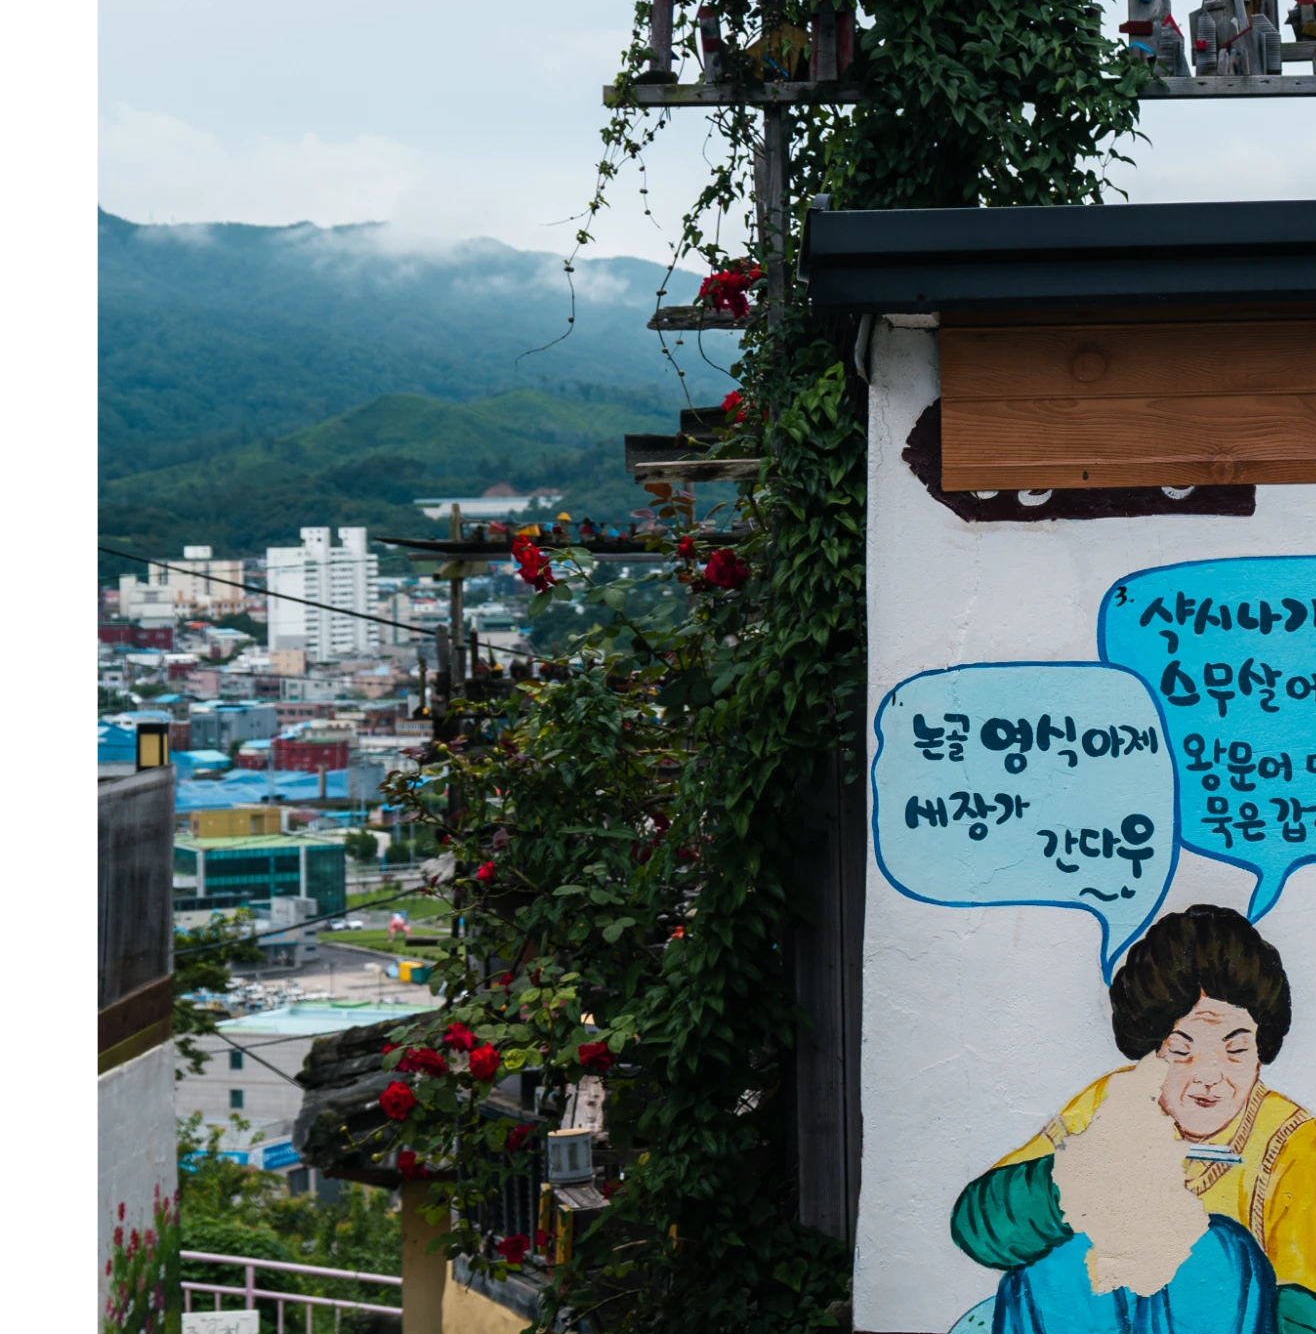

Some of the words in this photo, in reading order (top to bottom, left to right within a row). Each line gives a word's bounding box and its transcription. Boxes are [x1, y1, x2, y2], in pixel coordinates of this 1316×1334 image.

[913, 714, 969, 761] 논골
[1184, 734, 1292, 791] 왕문어
[905, 792, 1030, 840] 새장가
